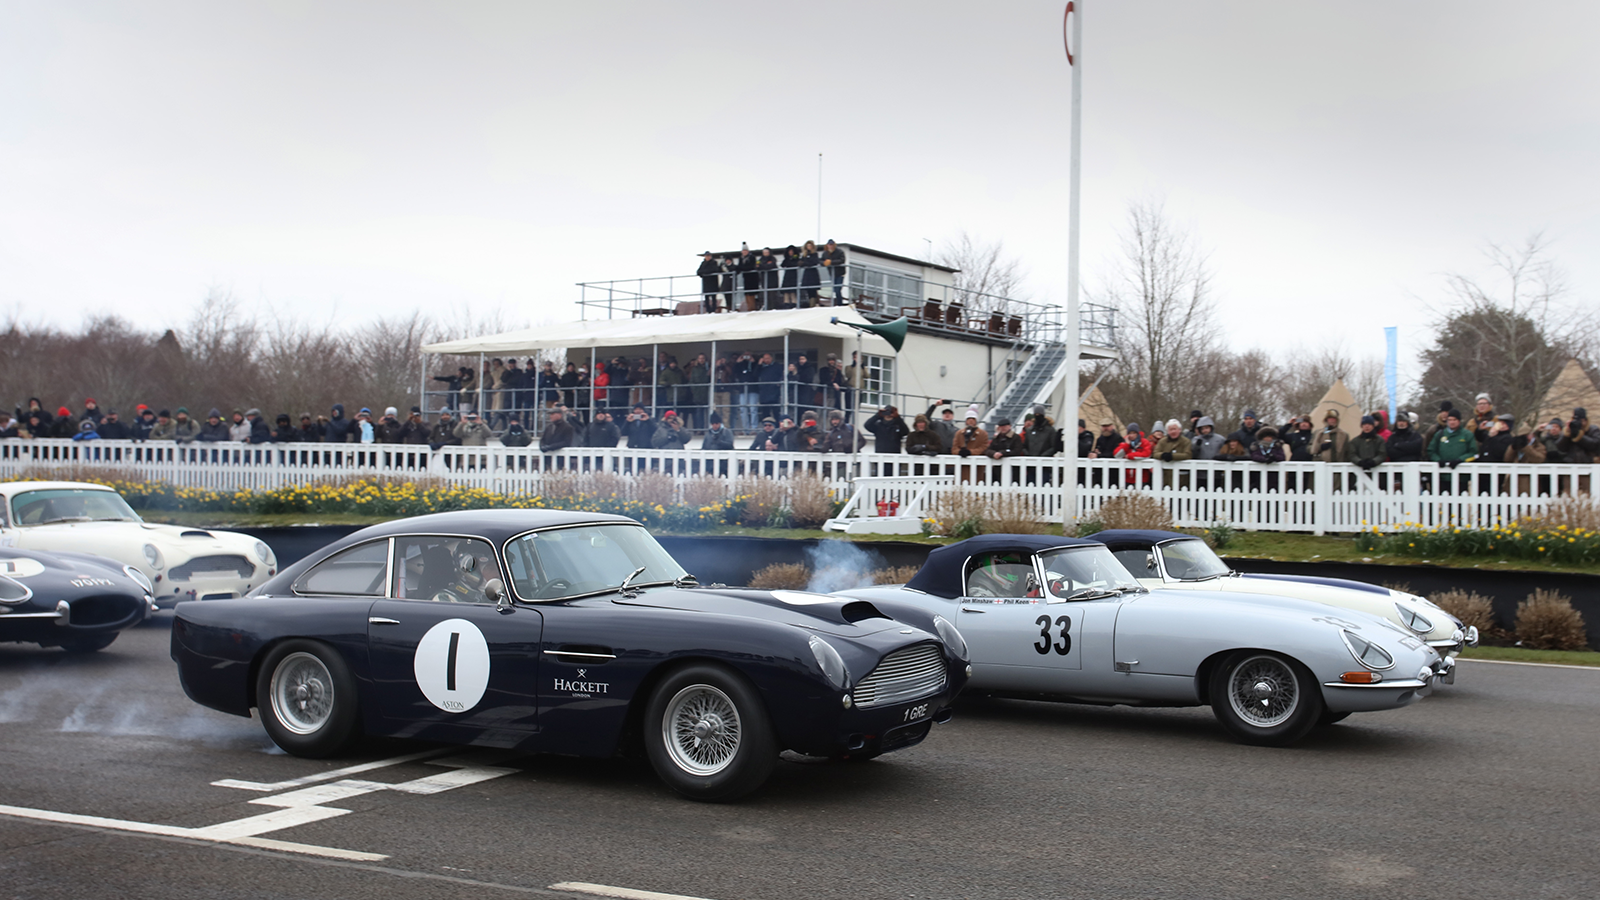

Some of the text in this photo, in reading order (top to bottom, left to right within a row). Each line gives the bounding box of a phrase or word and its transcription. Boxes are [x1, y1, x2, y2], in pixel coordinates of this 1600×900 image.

[1033, 614, 1072, 656] 33
[447, 632, 460, 690] 1
[554, 678, 609, 693] HACKETT
[442, 700, 465, 709] ASTON
[904, 703, 928, 721] 1 GRE
